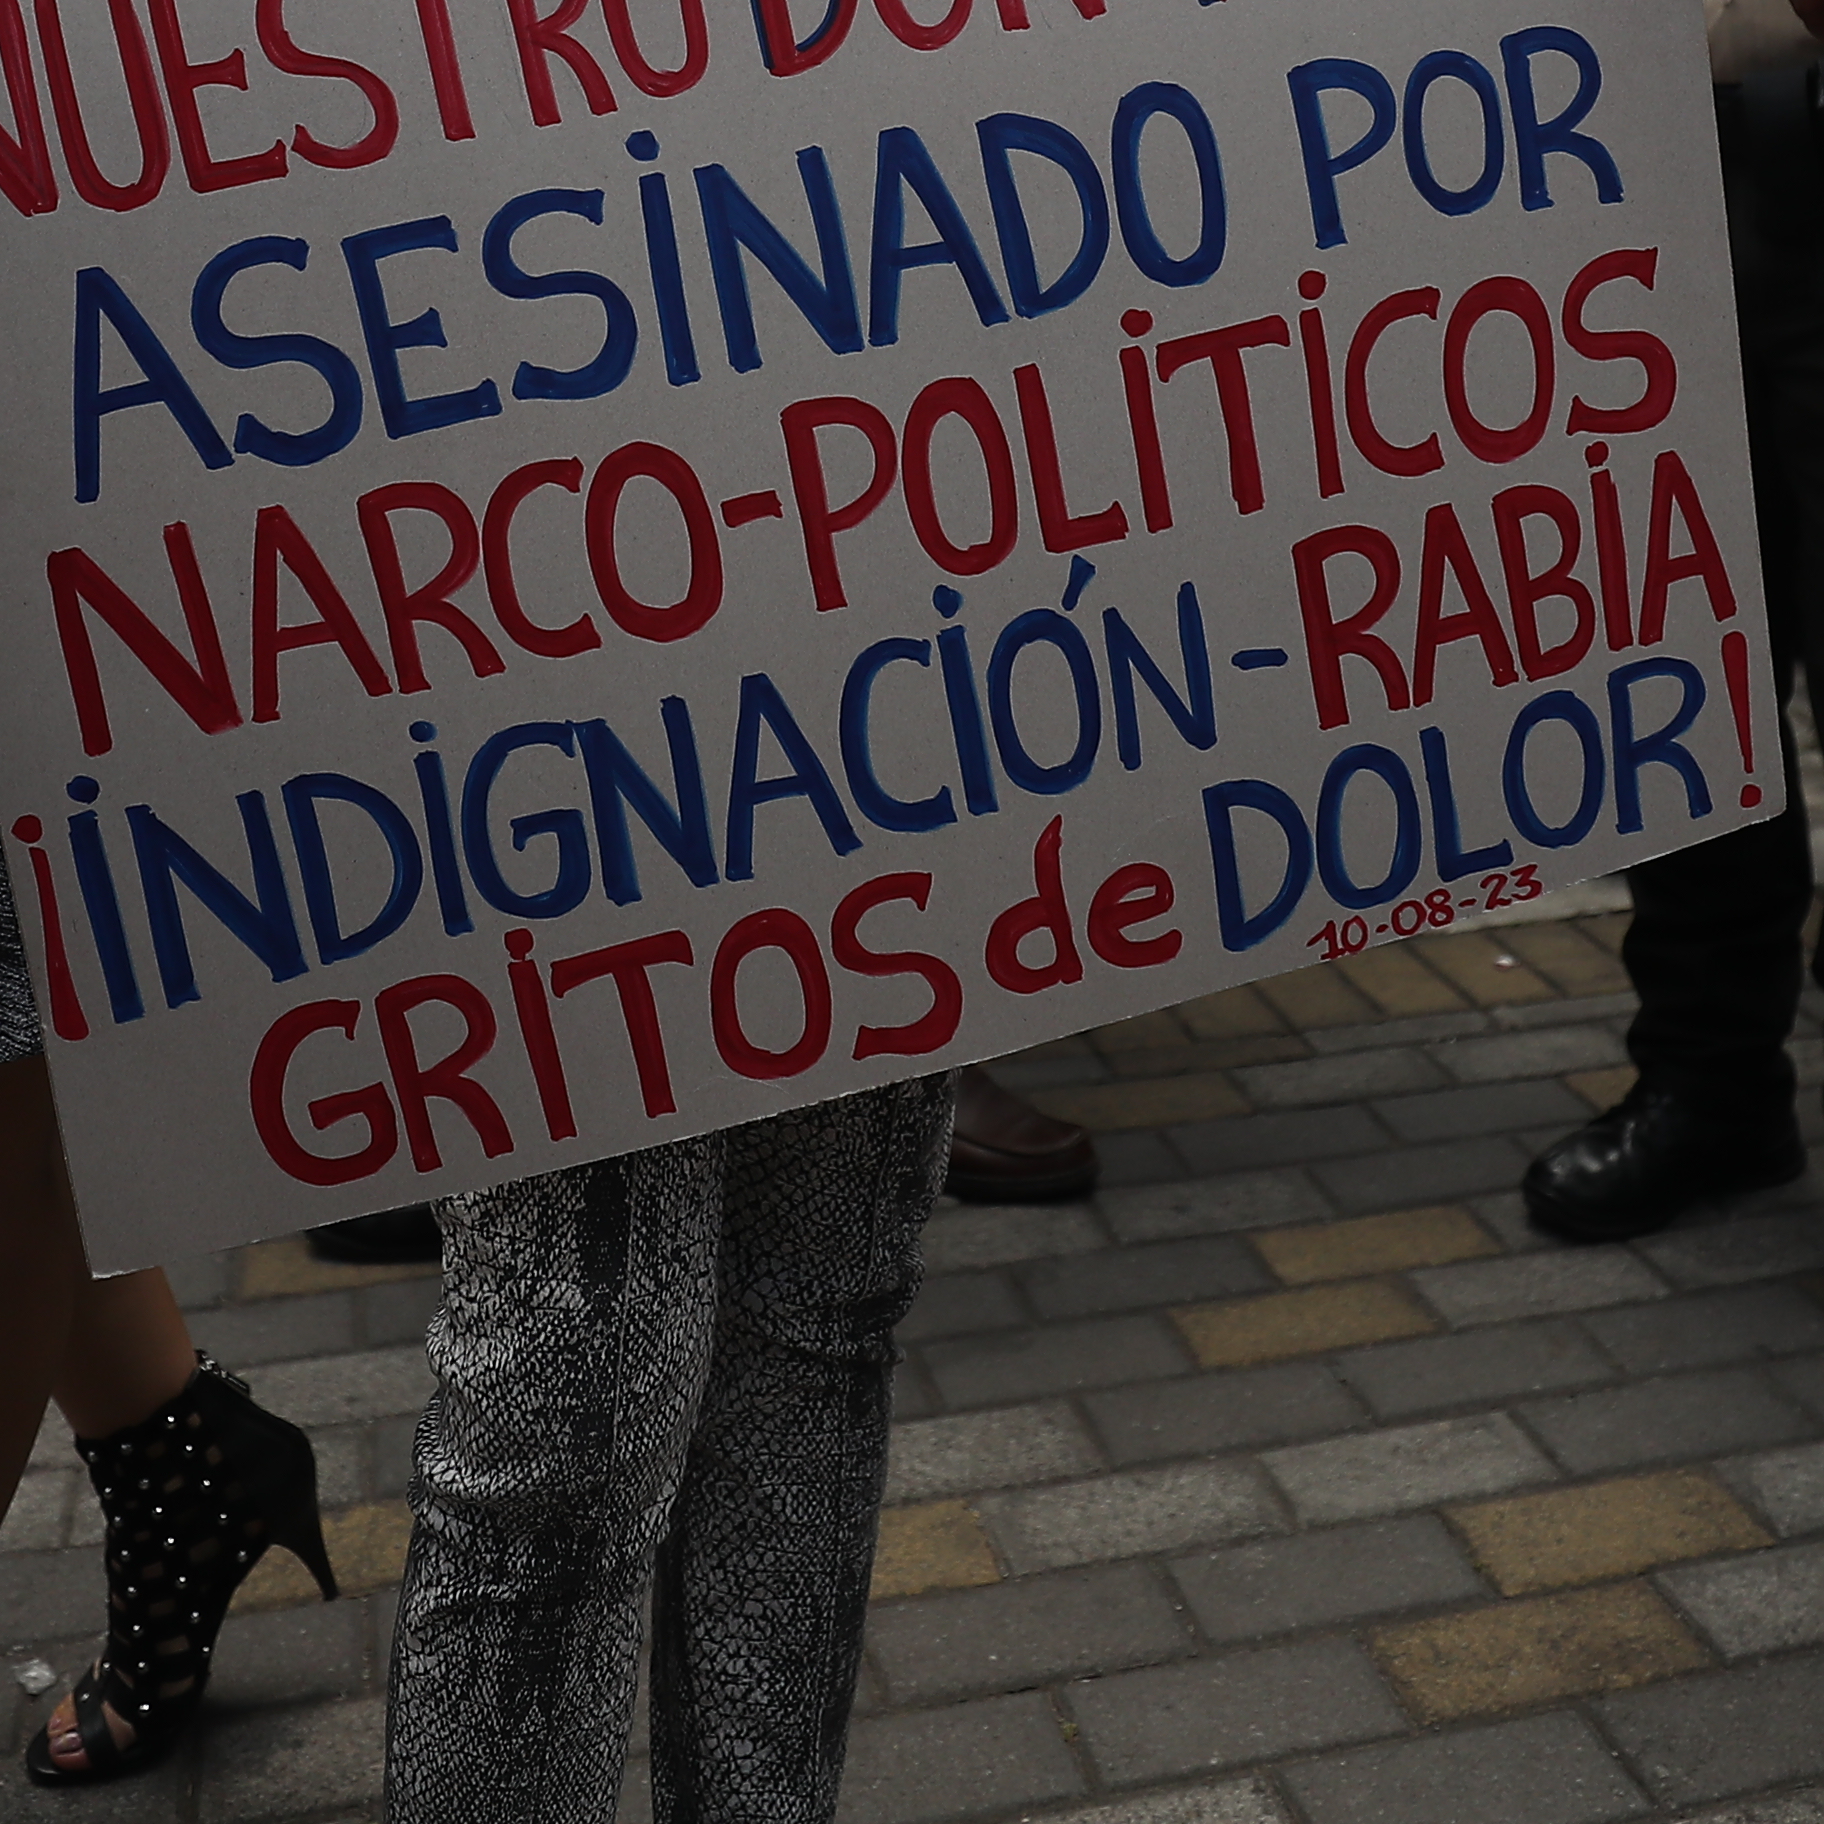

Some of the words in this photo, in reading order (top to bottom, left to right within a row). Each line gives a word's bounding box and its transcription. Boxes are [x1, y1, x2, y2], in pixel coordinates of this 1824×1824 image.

[78, 81, 1228, 504] ASESINADO
[1288, 26, 1623, 242] POR
[251, 871, 962, 1185] GRITOS
[986, 817, 1182, 995] de
[1204, 631, 1762, 953] DOLOR!
[1305, 862, 1544, 961] 10-08-23
